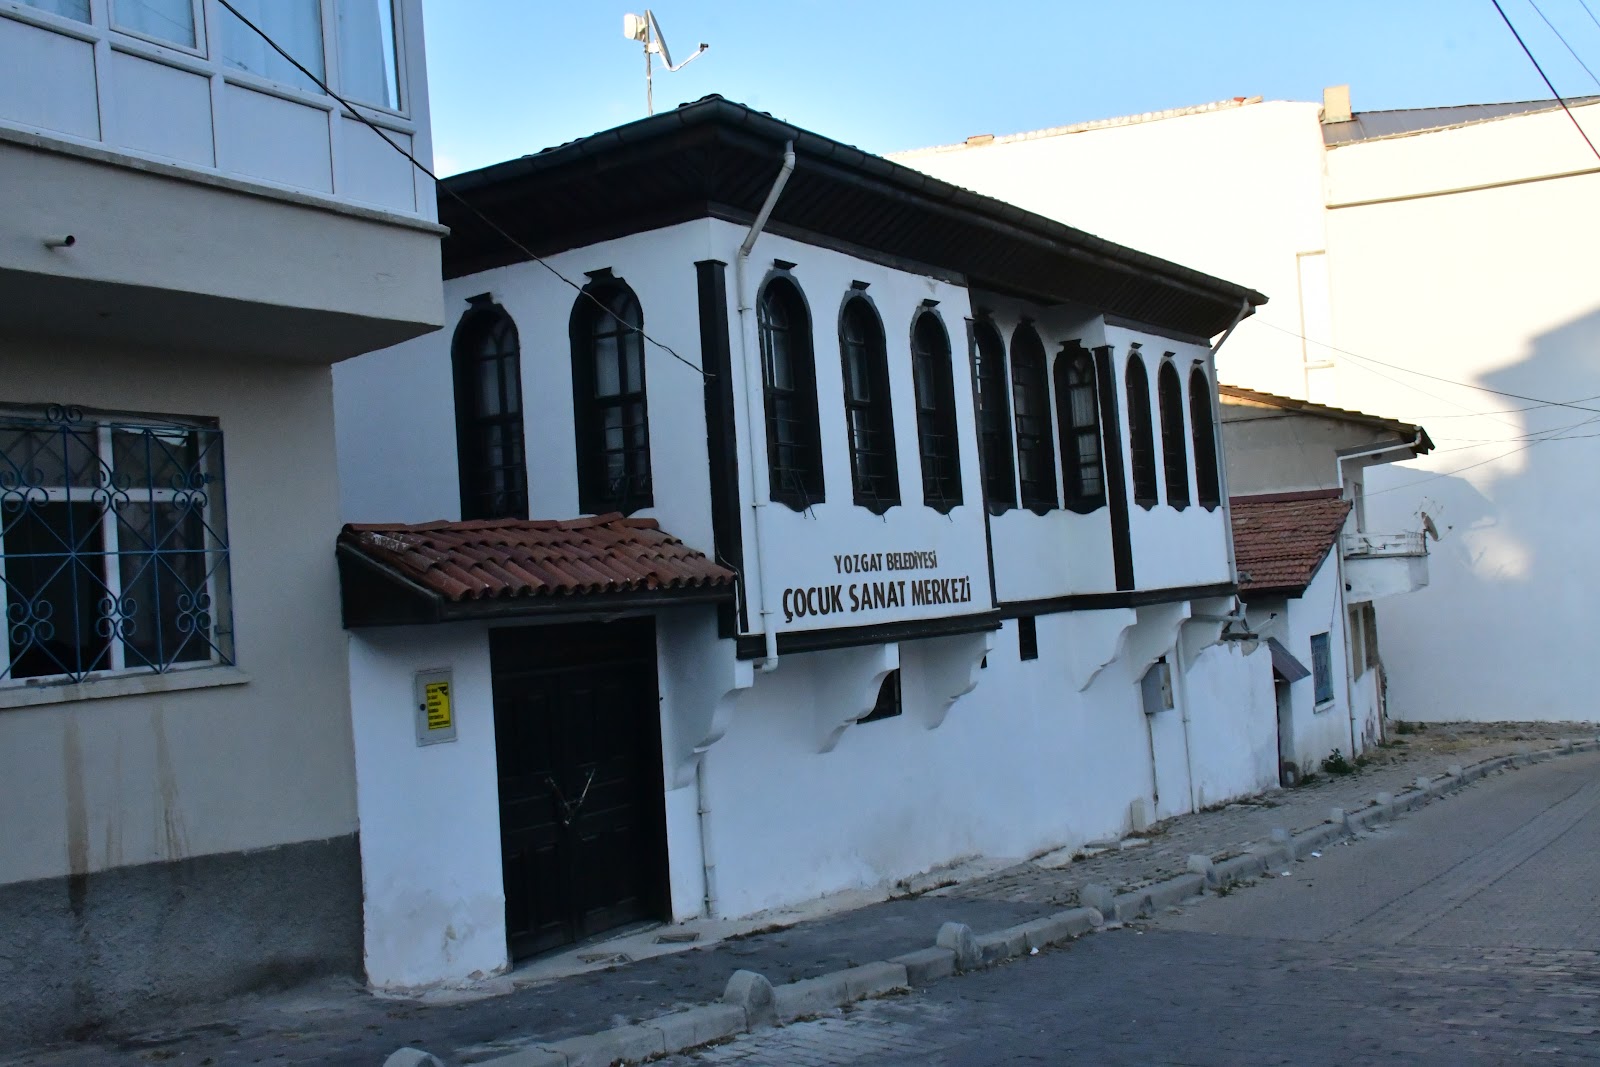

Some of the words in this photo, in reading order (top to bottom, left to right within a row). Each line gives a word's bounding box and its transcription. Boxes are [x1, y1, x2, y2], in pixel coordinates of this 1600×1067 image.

[834, 553, 882, 574] YOZGAT
[886, 550, 938, 571] BELEDİYESİ
[782, 584, 844, 623] ÇOCUK
[849, 580, 905, 613] SANAT
[911, 575, 971, 606] MERKEZİ
